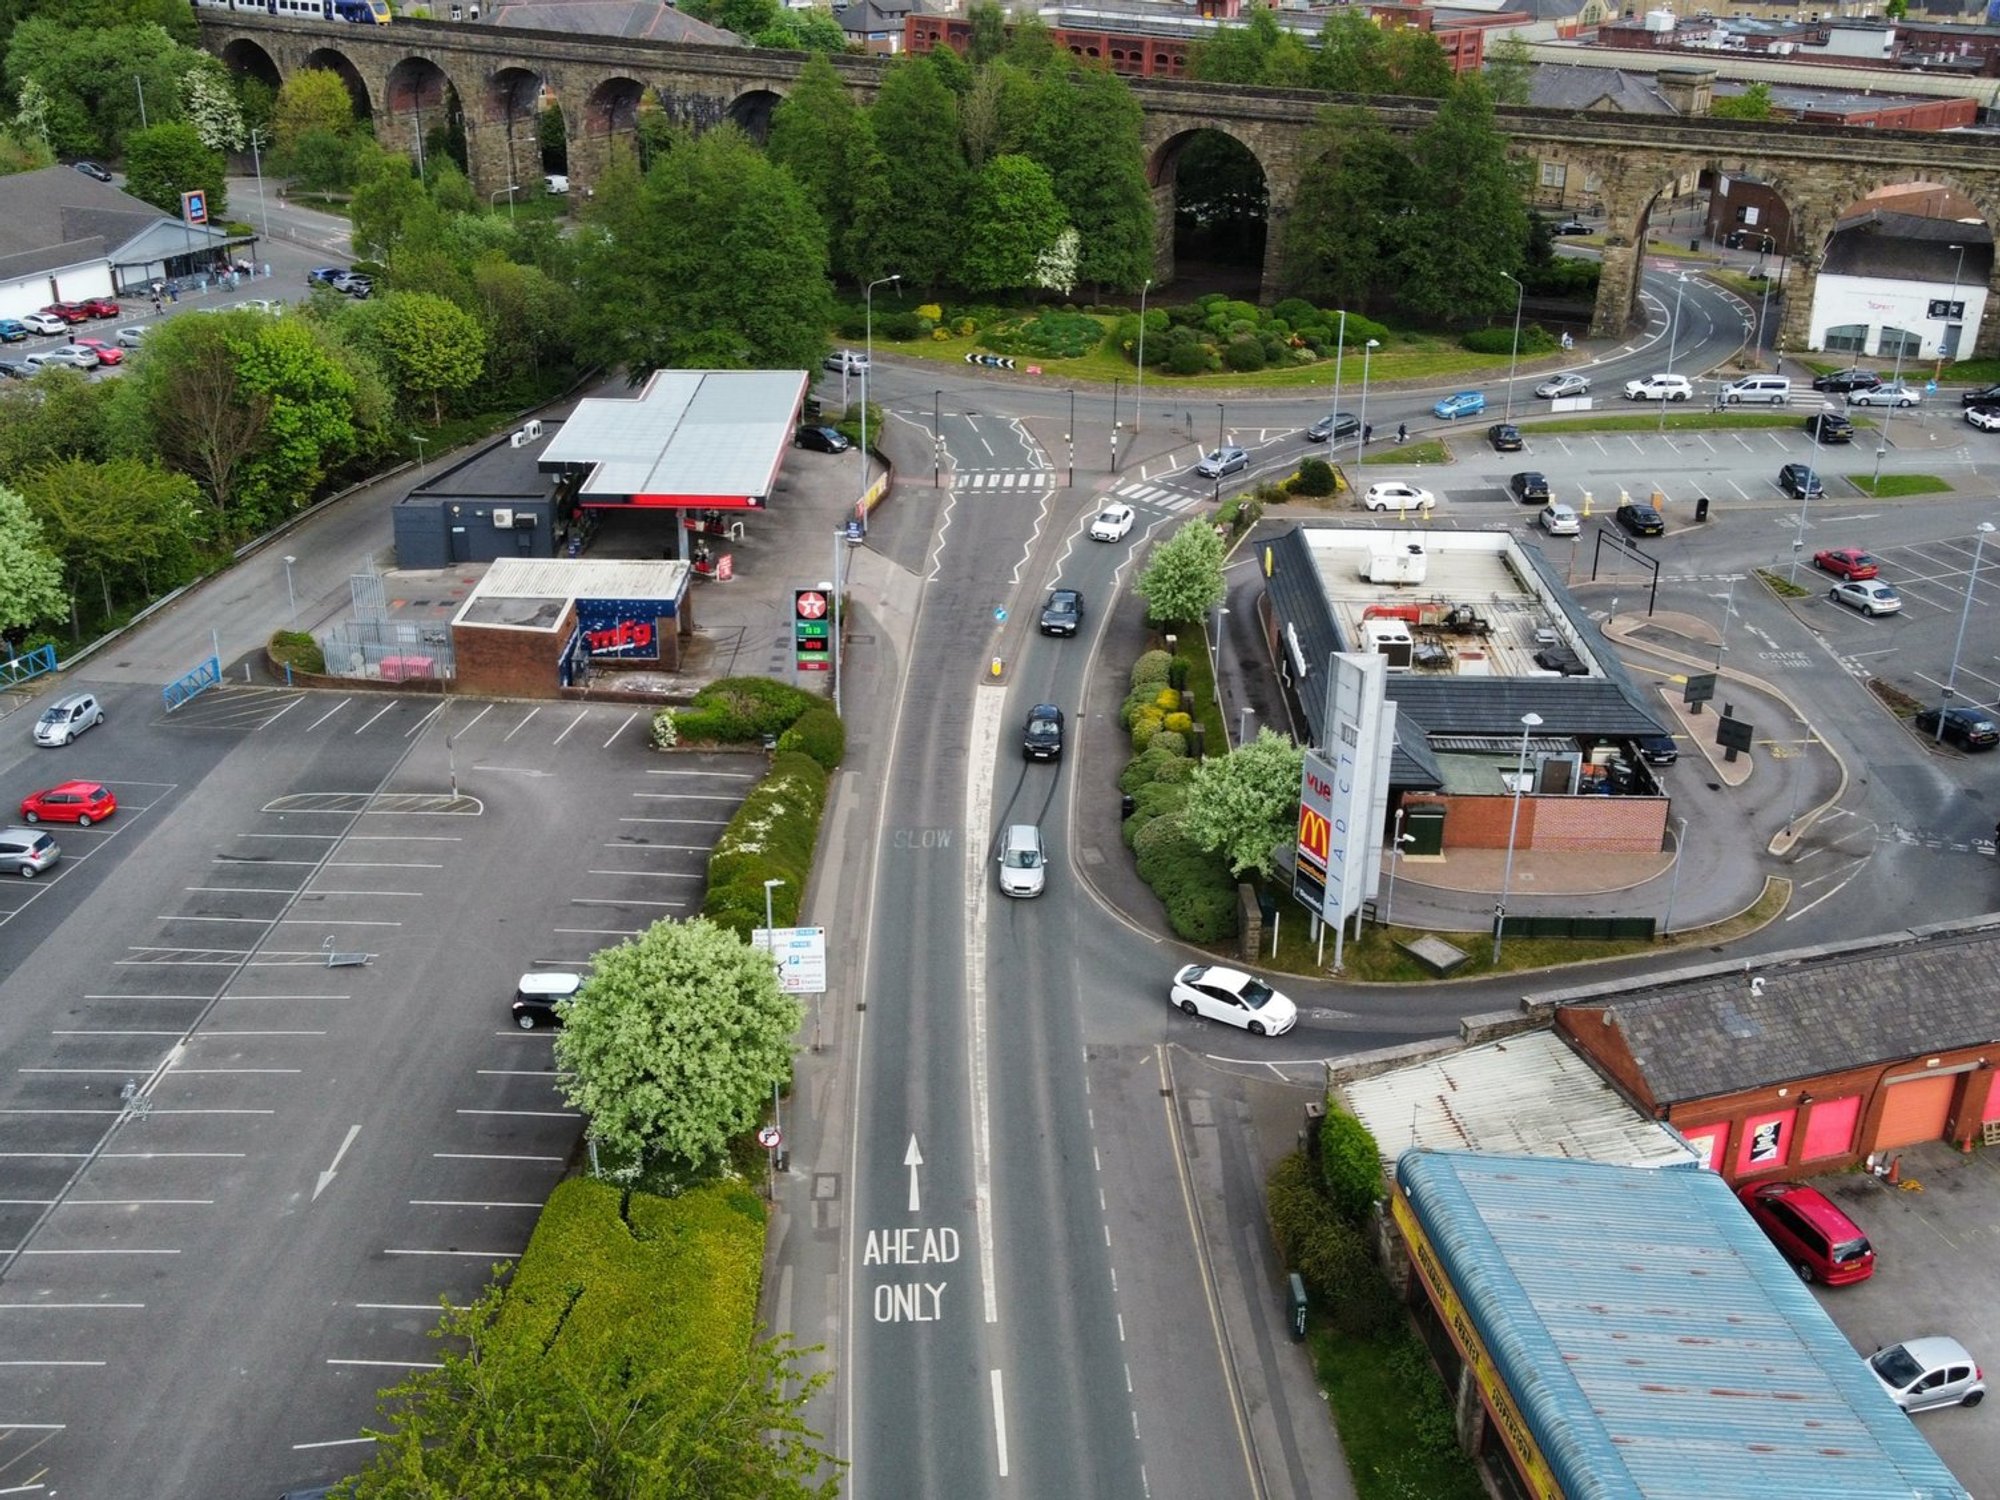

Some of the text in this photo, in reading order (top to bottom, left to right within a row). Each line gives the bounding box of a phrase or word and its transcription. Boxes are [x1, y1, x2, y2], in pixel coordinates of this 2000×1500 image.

[894, 829, 953, 849] SLOW
[863, 1227, 960, 1266] AHEAD
[874, 1281, 948, 1322] ONLY
